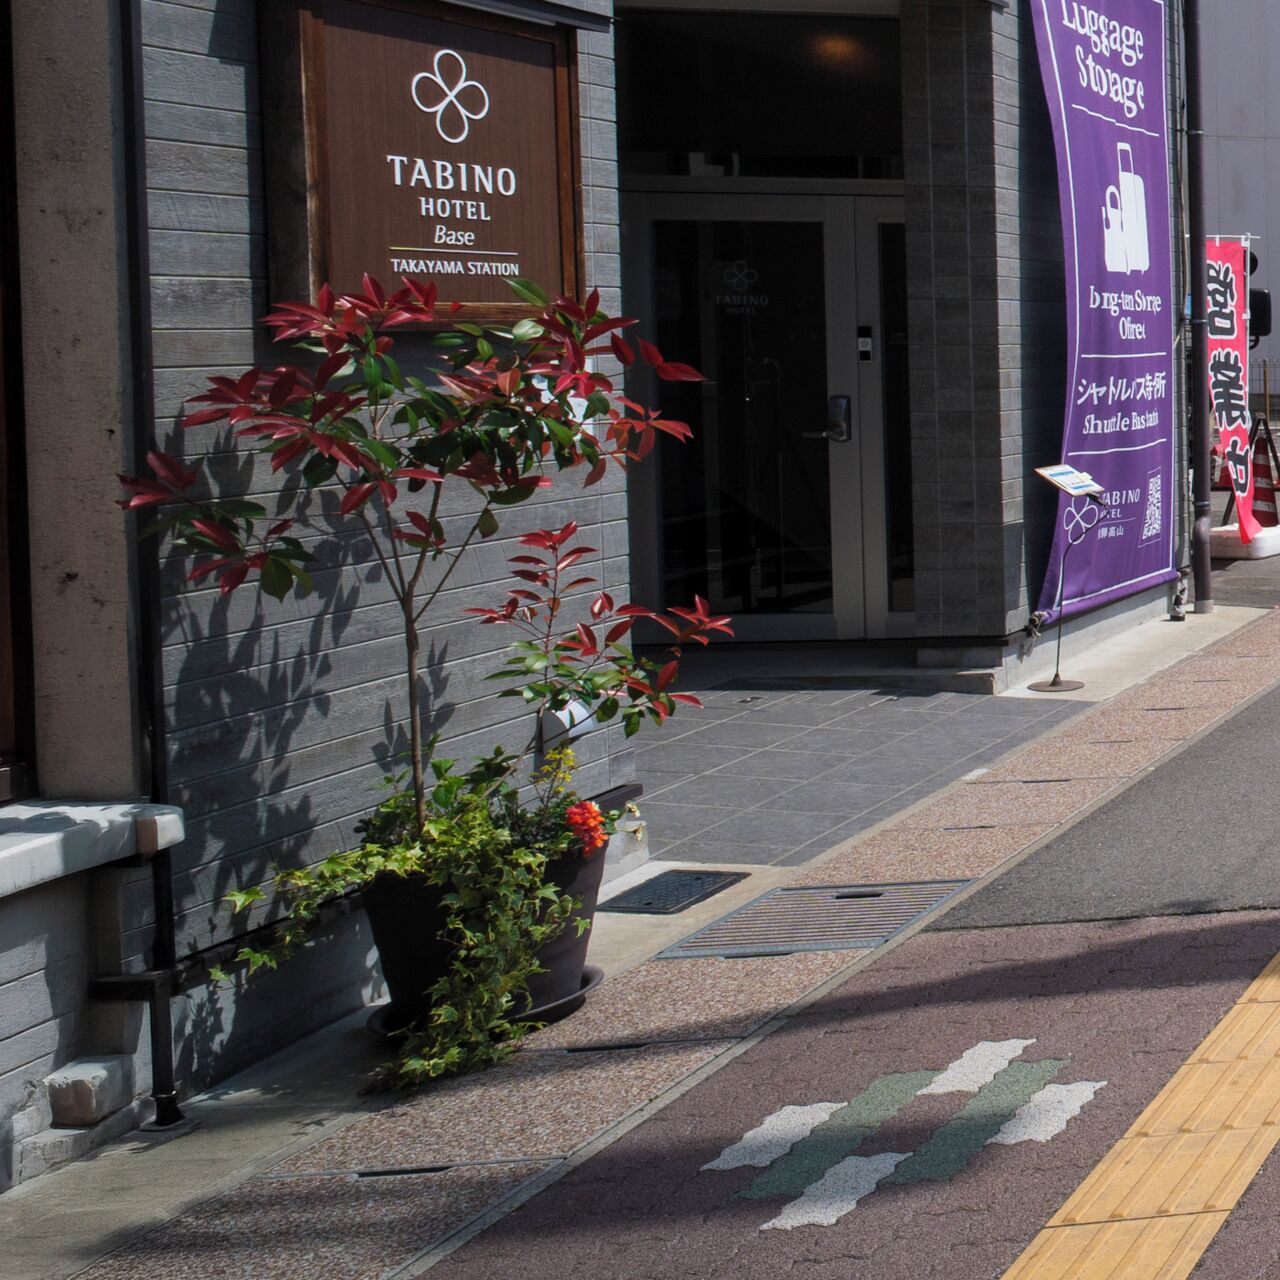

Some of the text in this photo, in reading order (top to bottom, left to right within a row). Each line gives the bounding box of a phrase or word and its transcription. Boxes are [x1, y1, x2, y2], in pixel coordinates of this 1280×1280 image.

[387, 155, 516, 196] TABINO
[420, 197, 490, 221] HOTEL
[434, 225, 475, 246] Base
[390, 258, 519, 276] TAKAYAMA STATION
[715, 295, 769, 305] TABINO
[1082, 412, 1130, 434] Shuttle
